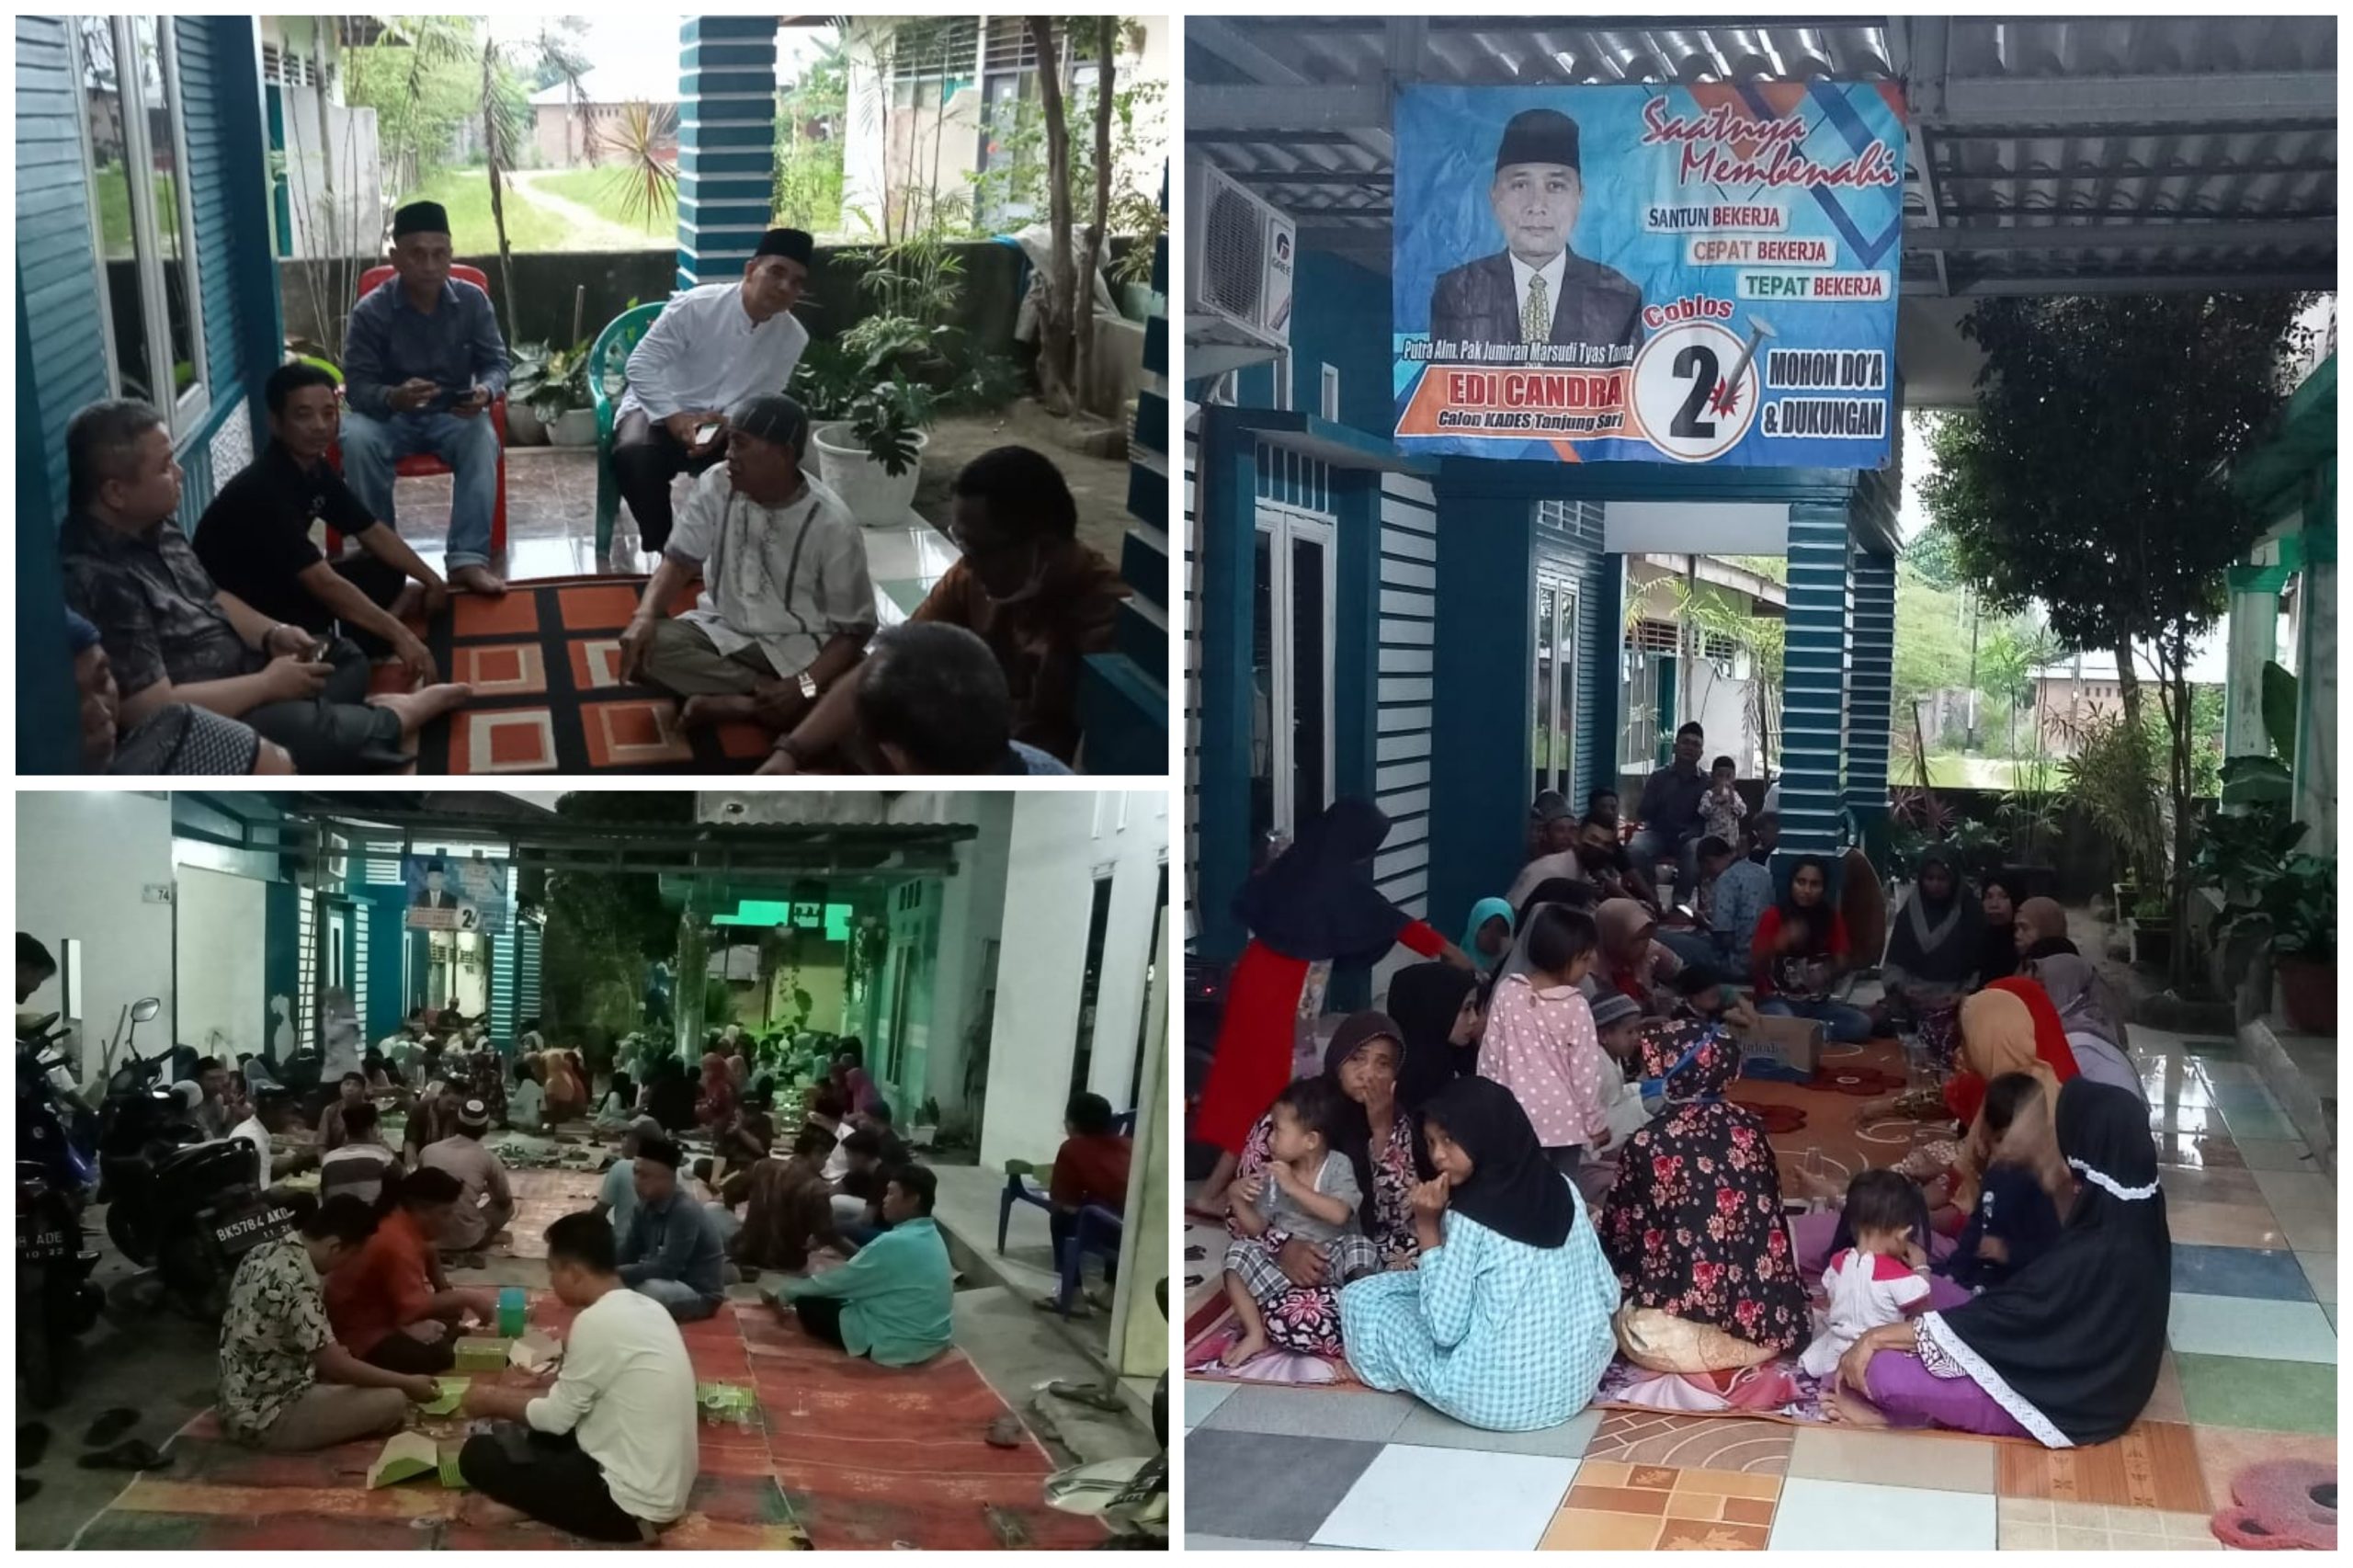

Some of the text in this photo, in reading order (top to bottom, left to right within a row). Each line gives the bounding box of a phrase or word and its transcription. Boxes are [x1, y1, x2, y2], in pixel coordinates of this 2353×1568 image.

[1643, 97, 1806, 157] Saatnya
[1679, 141, 1897, 187] Membenahi
[1649, 206, 1780, 228] SANTUN BEKERJA
[1694, 240, 1826, 261] CEPAT BEKERJA
[1745, 275, 1882, 297] TEPAT BEKERJA
[1643, 295, 1733, 328] Coblos
[1404, 340, 1433, 360] Putra
[1435, 342, 1459, 360] Alm.
[1461, 341, 1482, 359] Pak
[1483, 341, 1529, 362] Jumiran
[1529, 342, 1577, 363] Marsudi
[1579, 342, 1605, 364] Tyas
[1768, 351, 1882, 387] MOHON DO'A
[1448, 373, 1623, 407] EDI CANDRA
[1670, 345, 1719, 439] 2
[1438, 411, 1624, 432] Calon KADES Tanjung Sari
[1763, 401, 1883, 436] & DUKUNGAN
